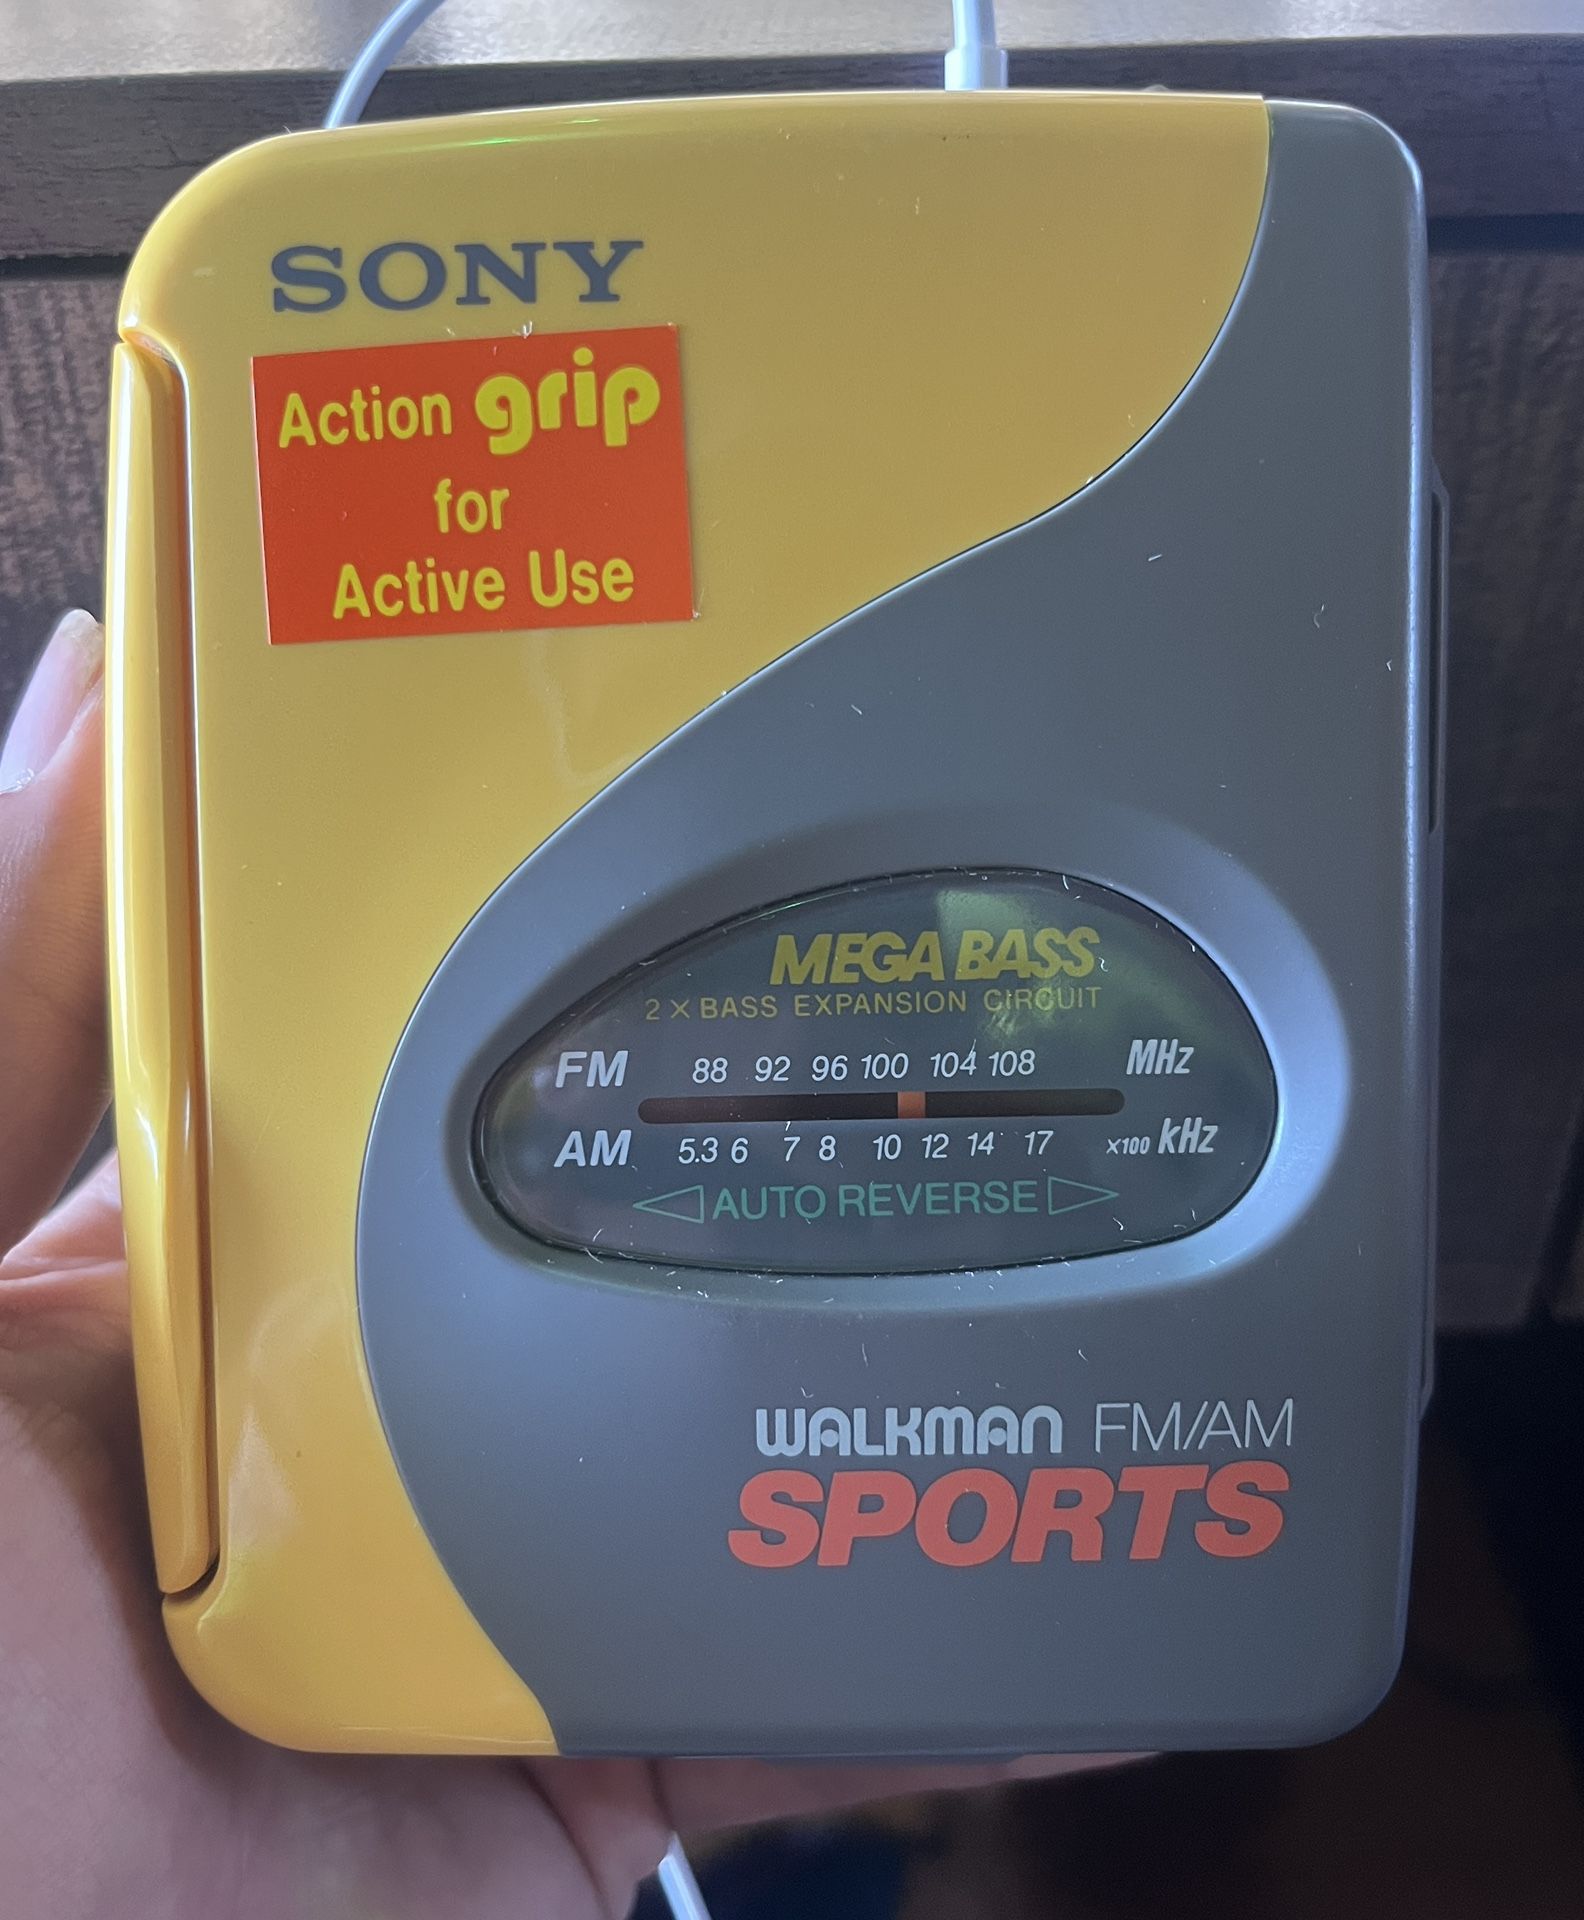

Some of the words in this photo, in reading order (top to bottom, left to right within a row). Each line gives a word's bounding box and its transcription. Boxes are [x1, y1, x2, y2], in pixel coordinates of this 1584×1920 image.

[270, 240, 644, 313] SONY
[278, 385, 452, 448] Action
[475, 346, 661, 456] grip
[434, 478, 510, 534] for
[332, 558, 506, 619] Active
[529, 548, 634, 608] Use
[769, 930, 945, 985] MEGA
[955, 926, 1100, 981] BASS
[646, 999, 660, 1021] 2
[701, 994, 778, 1019] BASS
[794, 990, 967, 1018] EXPANSION
[983, 986, 1102, 1013] CIRCUIT
[555, 1050, 629, 1088] FM
[692, 1058, 728, 1083] 88
[754, 1056, 791, 1082] 92
[811, 1054, 848, 1081] 96
[861, 1053, 909, 1080] 100
[930, 1051, 977, 1078] 104
[989, 1049, 1035, 1077] 108
[1126, 1039, 1194, 1075] MHz
[553, 1129, 632, 1168] AM
[678, 1137, 719, 1164] 5.3
[730, 1138, 749, 1164] 6
[783, 1136, 801, 1162] 7
[818, 1135, 836, 1161] 8
[873, 1133, 901, 1160] 10
[921, 1133, 949, 1159] 12
[967, 1132, 995, 1156] 14
[1024, 1130, 1054, 1155] 17
[1158, 1117, 1218, 1154] kHz
[712, 1185, 826, 1221] AUTO
[837, 1180, 1039, 1217] REVERSE
[755, 1405, 1063, 1457] WALKMAN
[1095, 1398, 1293, 1453] FM/AM
[727, 1459, 1290, 1568] SPORTS
